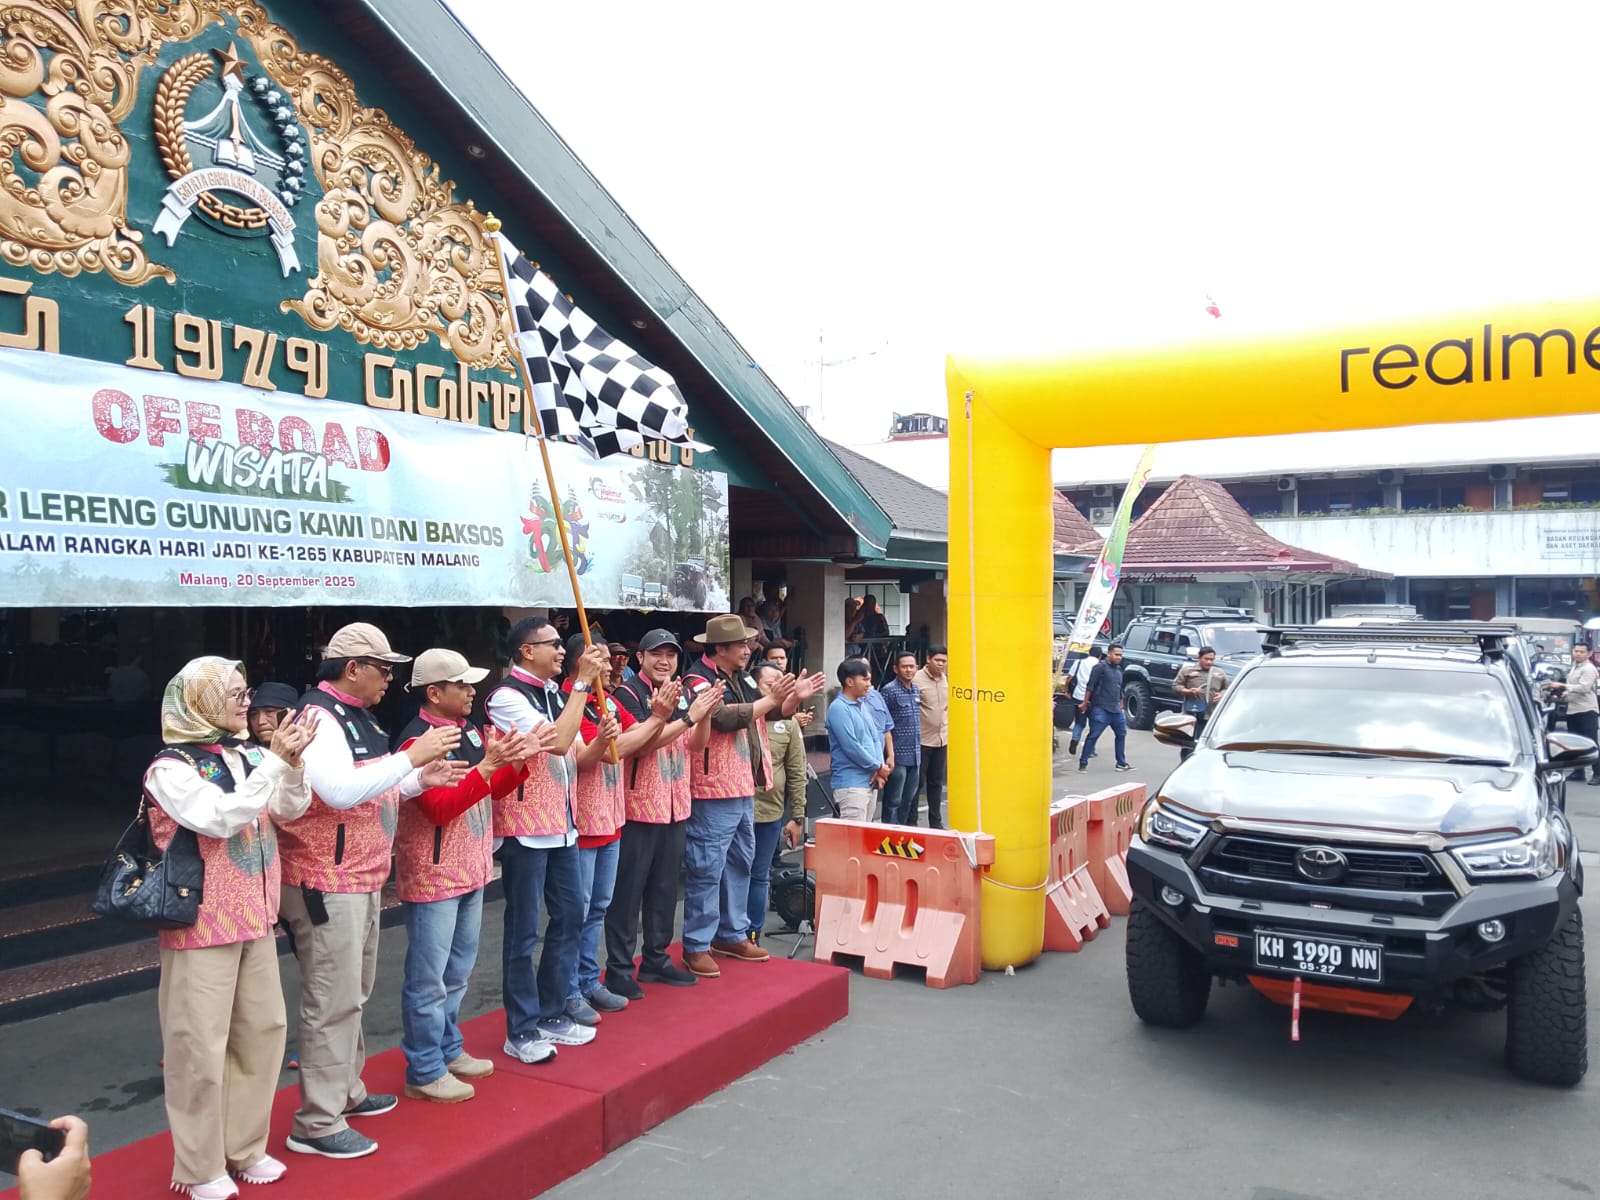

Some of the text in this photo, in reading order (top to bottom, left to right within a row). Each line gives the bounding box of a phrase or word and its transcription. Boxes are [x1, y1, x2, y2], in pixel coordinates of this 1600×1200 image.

[124, 303, 329, 399] 1979
[91, 388, 222, 447] OFF
[235, 408, 391, 472] ROAD
[184, 439, 329, 499] WISATA
[20, 491, 156, 527] LERENG
[166, 501, 292, 534] GUNUNG
[299, 511, 364, 538] KAWI
[370, 516, 418, 542] DAN
[425, 520, 504, 547] BAKSOS
[64, 536, 152, 555] RANGKA
[159, 540, 205, 558] HARI
[212, 543, 252, 559] JADI
[257, 545, 327, 562] KE-1265
[332, 548, 416, 566] KABUPATEN
[421, 552, 480, 568] MALANG
[180, 573, 355, 588] Malang, 20 September 2025
[1259, 936, 1284, 958] KH
[1292, 940, 1342, 966] 1990
[1351, 947, 1377, 970] NN
